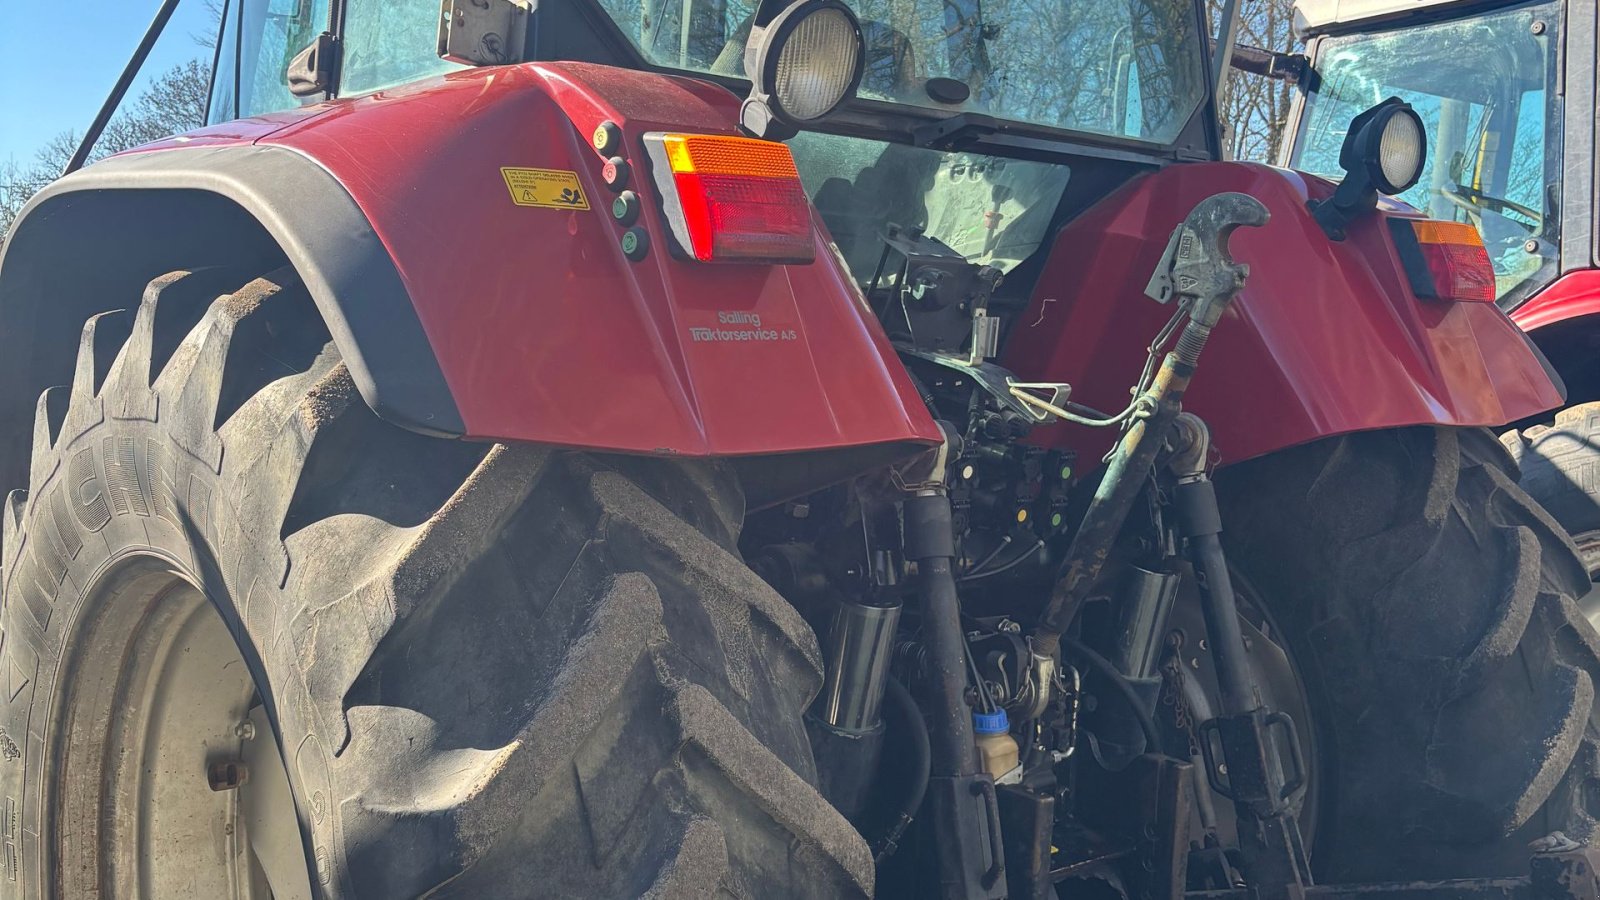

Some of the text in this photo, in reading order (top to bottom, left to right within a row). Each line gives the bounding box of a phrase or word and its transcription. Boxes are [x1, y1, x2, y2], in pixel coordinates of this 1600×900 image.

[718, 310, 761, 326] Salling
[689, 327, 797, 342] Traktorservice A/S
